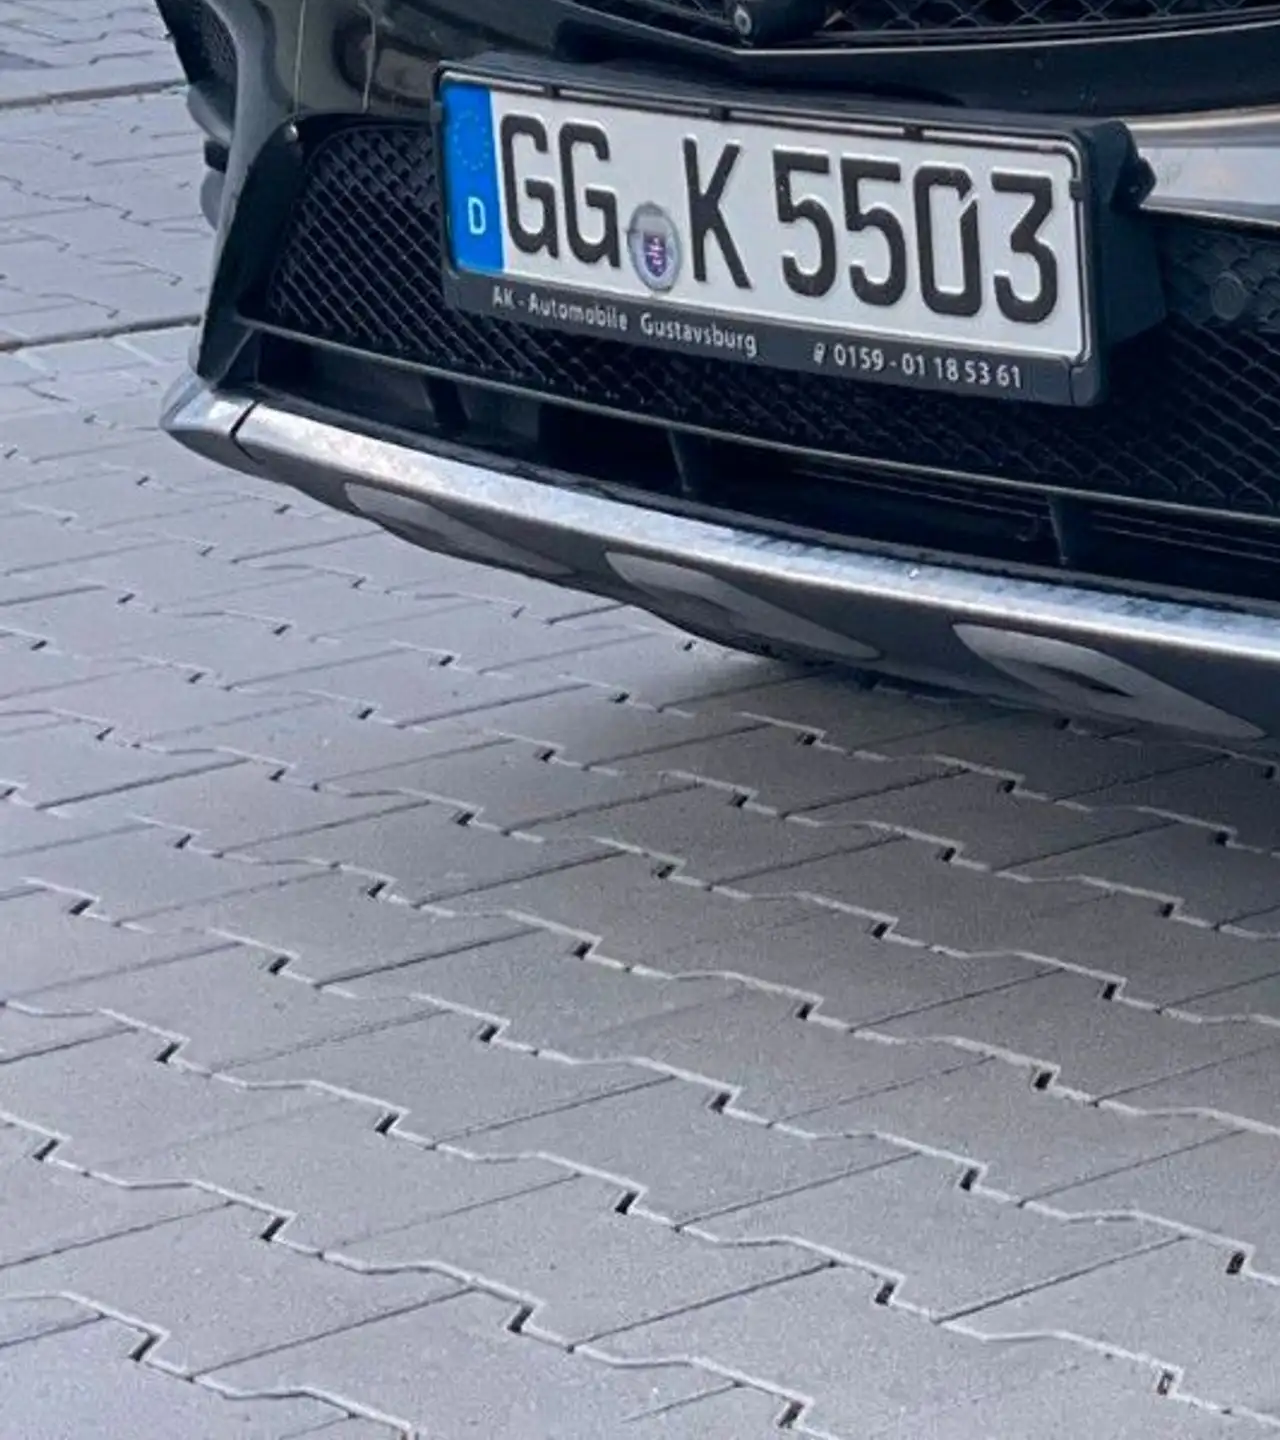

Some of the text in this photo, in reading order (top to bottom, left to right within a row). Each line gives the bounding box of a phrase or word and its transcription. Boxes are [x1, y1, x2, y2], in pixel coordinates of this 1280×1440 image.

[468, 197, 486, 235] D
[501, 113, 1058, 324] GG K 5503
[641, 313, 758, 358] Gustavsburg
